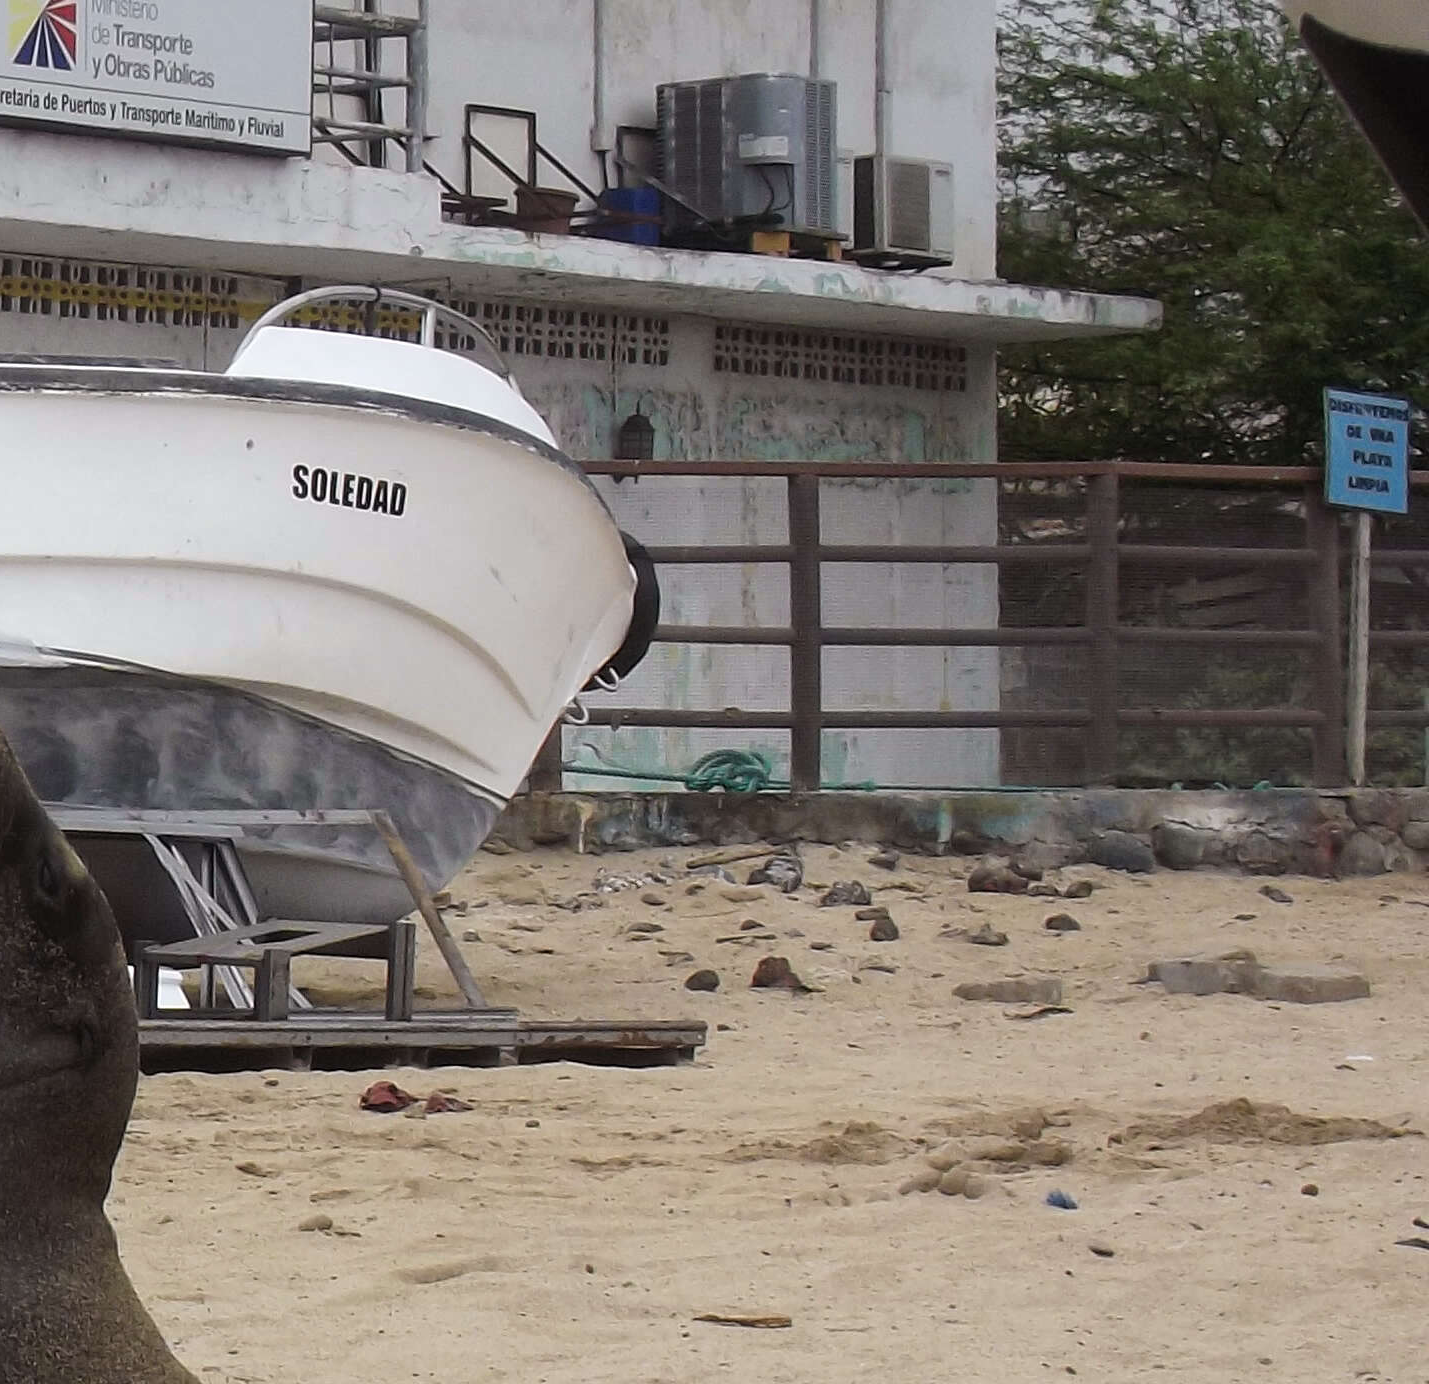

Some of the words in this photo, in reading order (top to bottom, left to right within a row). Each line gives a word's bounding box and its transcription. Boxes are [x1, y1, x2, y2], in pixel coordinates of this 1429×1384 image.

[92, 0, 159, 21] Ministerio
[92, 23, 110, 45] de
[113, 24, 194, 56] Transporte
[92, 57, 101, 79] y
[105, 53, 150, 81] Obras
[154, 59, 215, 88] Públicas
[43, 92, 58, 111] de
[61, 94, 106, 115] Puertos
[110, 102, 117, 121] y
[121, 102, 182, 126] Transporte
[238, 120, 245, 137] y
[248, 116, 284, 138] Fluvial
[1353, 450, 1393, 467] PLAYA
[292, 464, 407, 517] SOLEDAD
